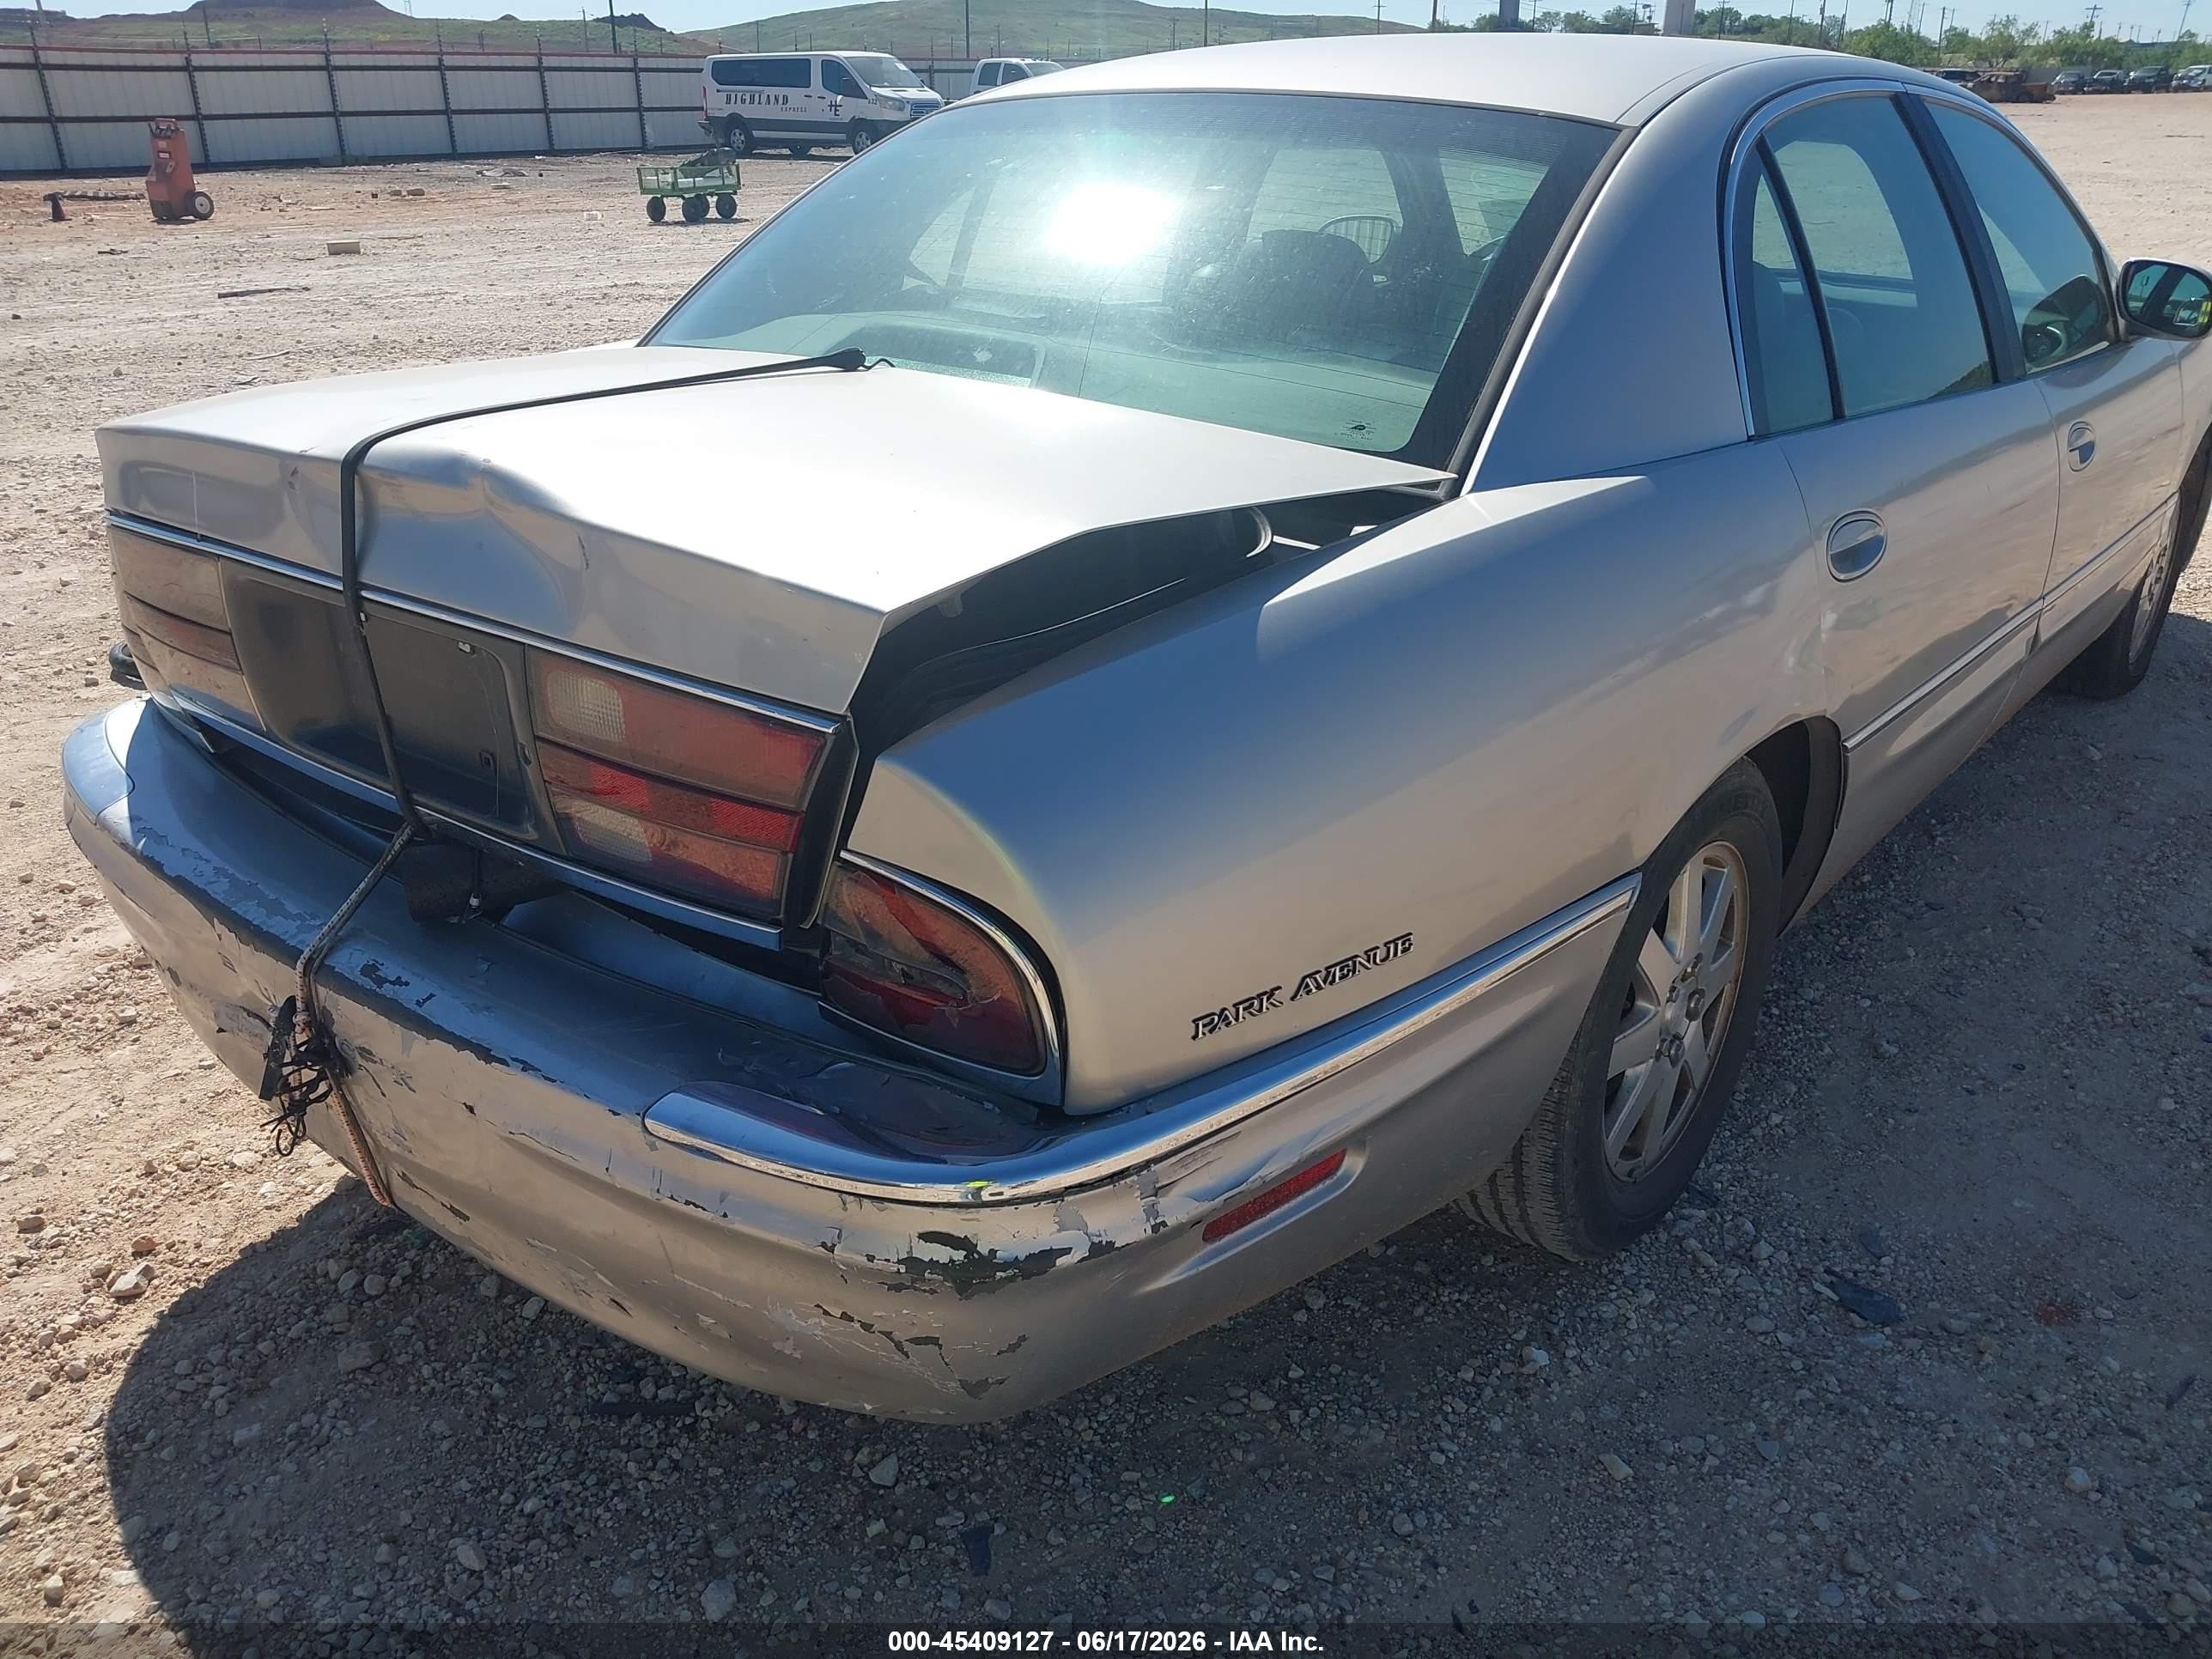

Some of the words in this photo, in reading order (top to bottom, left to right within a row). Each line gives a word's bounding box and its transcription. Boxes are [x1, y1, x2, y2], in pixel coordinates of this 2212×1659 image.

[725, 93, 789, 106] HIGHLAND
[1191, 985, 1284, 1041] PARK
[1290, 932, 1414, 1001] AVENUE
